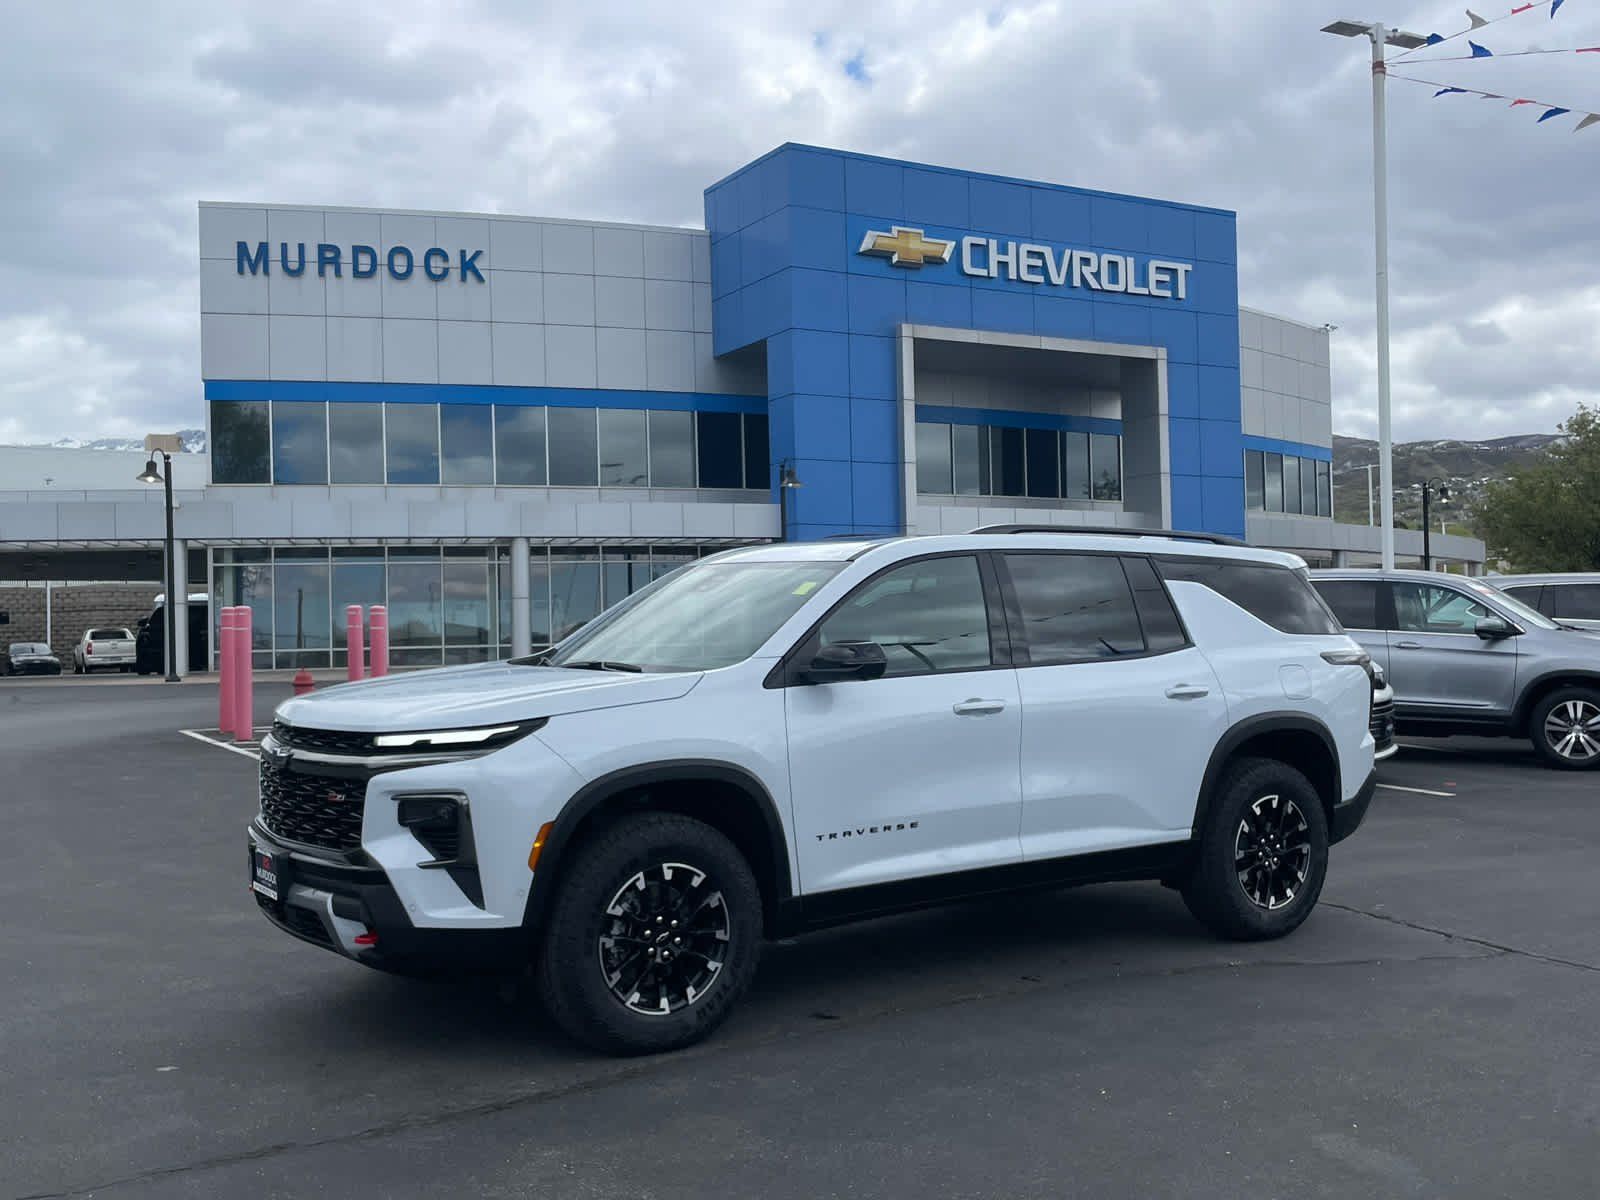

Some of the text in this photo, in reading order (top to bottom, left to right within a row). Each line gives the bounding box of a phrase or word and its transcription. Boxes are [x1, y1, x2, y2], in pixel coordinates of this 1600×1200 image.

[236, 241, 485, 283] MURDOCK
[962, 236, 1192, 299] CHEVROLET
[816, 821, 919, 841] TRAVERSE
